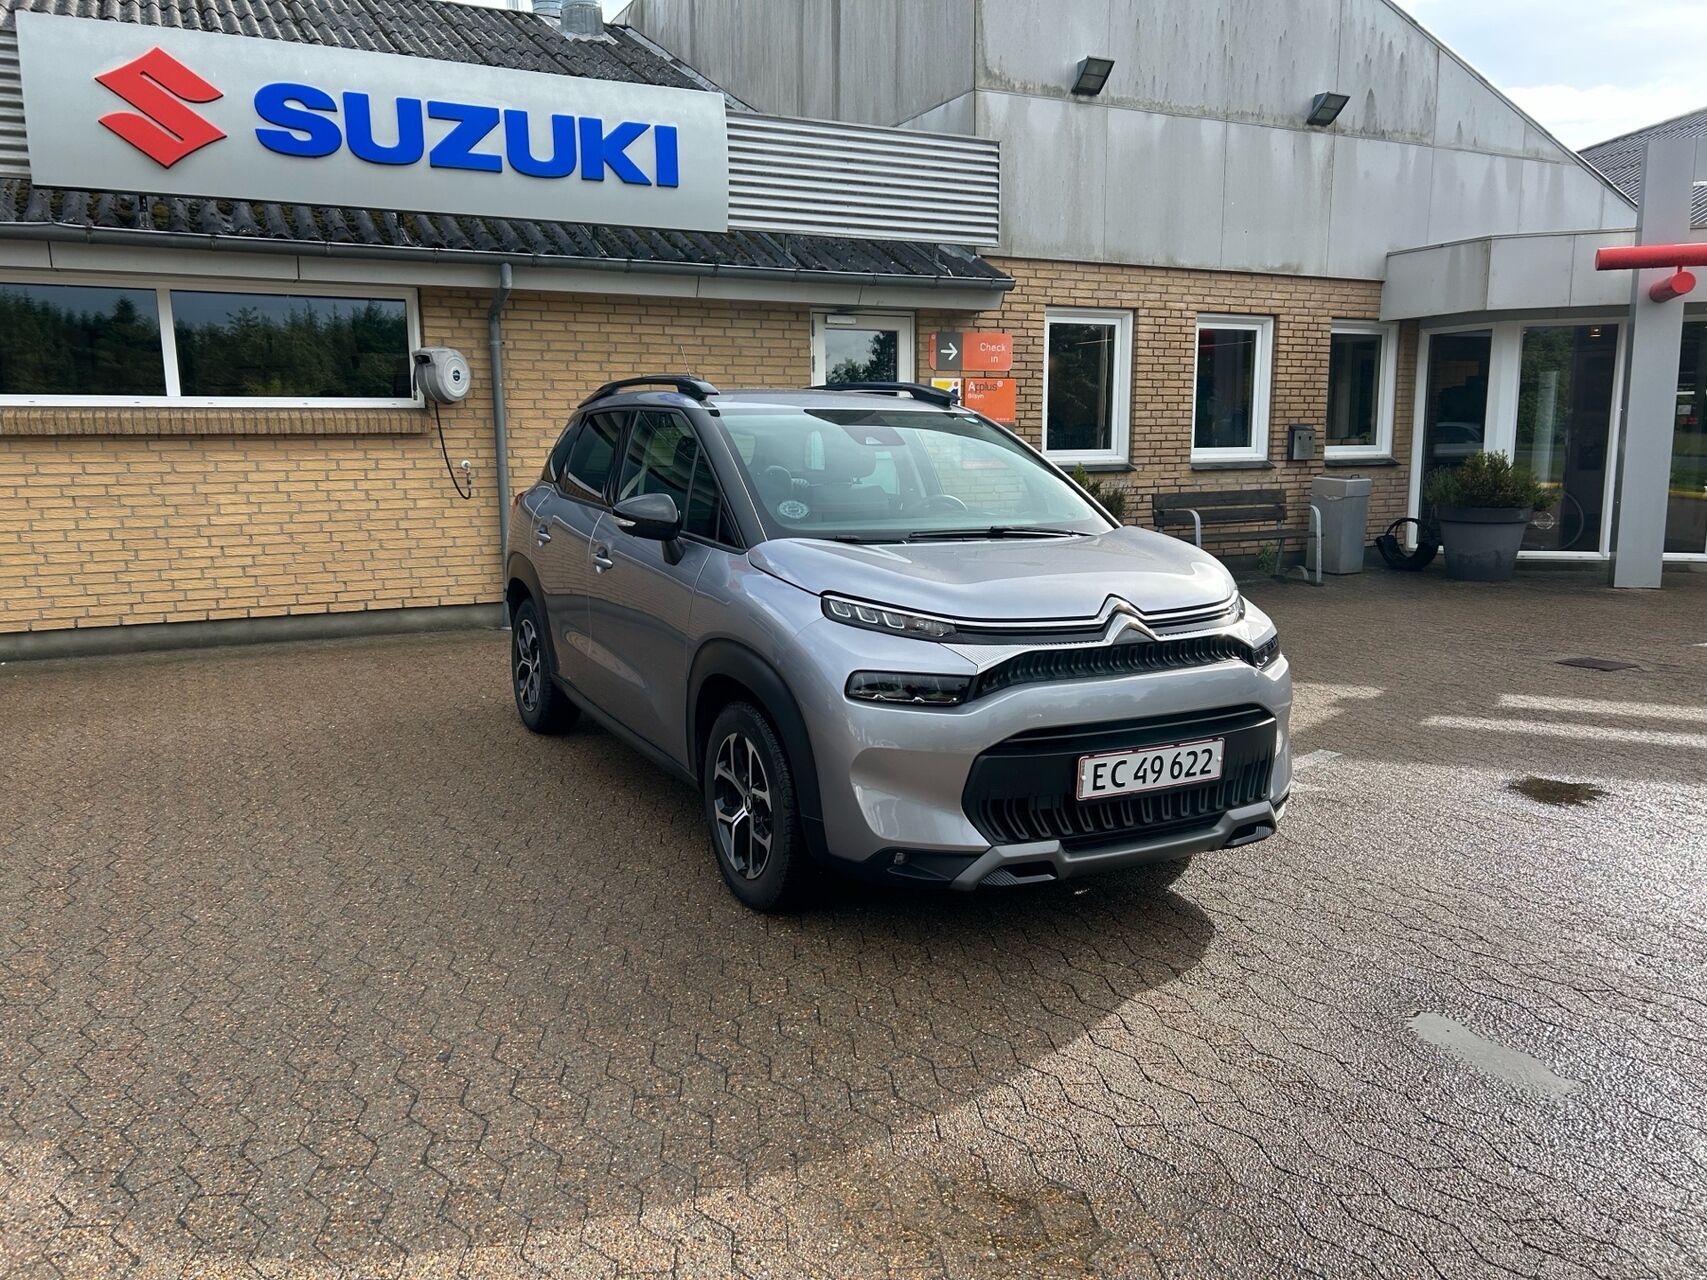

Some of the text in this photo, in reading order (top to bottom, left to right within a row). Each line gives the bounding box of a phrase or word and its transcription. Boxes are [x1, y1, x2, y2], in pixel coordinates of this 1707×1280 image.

[254, 82, 680, 188] SUZUKI
[979, 342, 1007, 353] Check
[990, 355, 999, 363] in
[1092, 760, 1127, 791] EC
[1133, 755, 1164, 784] 49
[1169, 748, 1213, 779] 622
